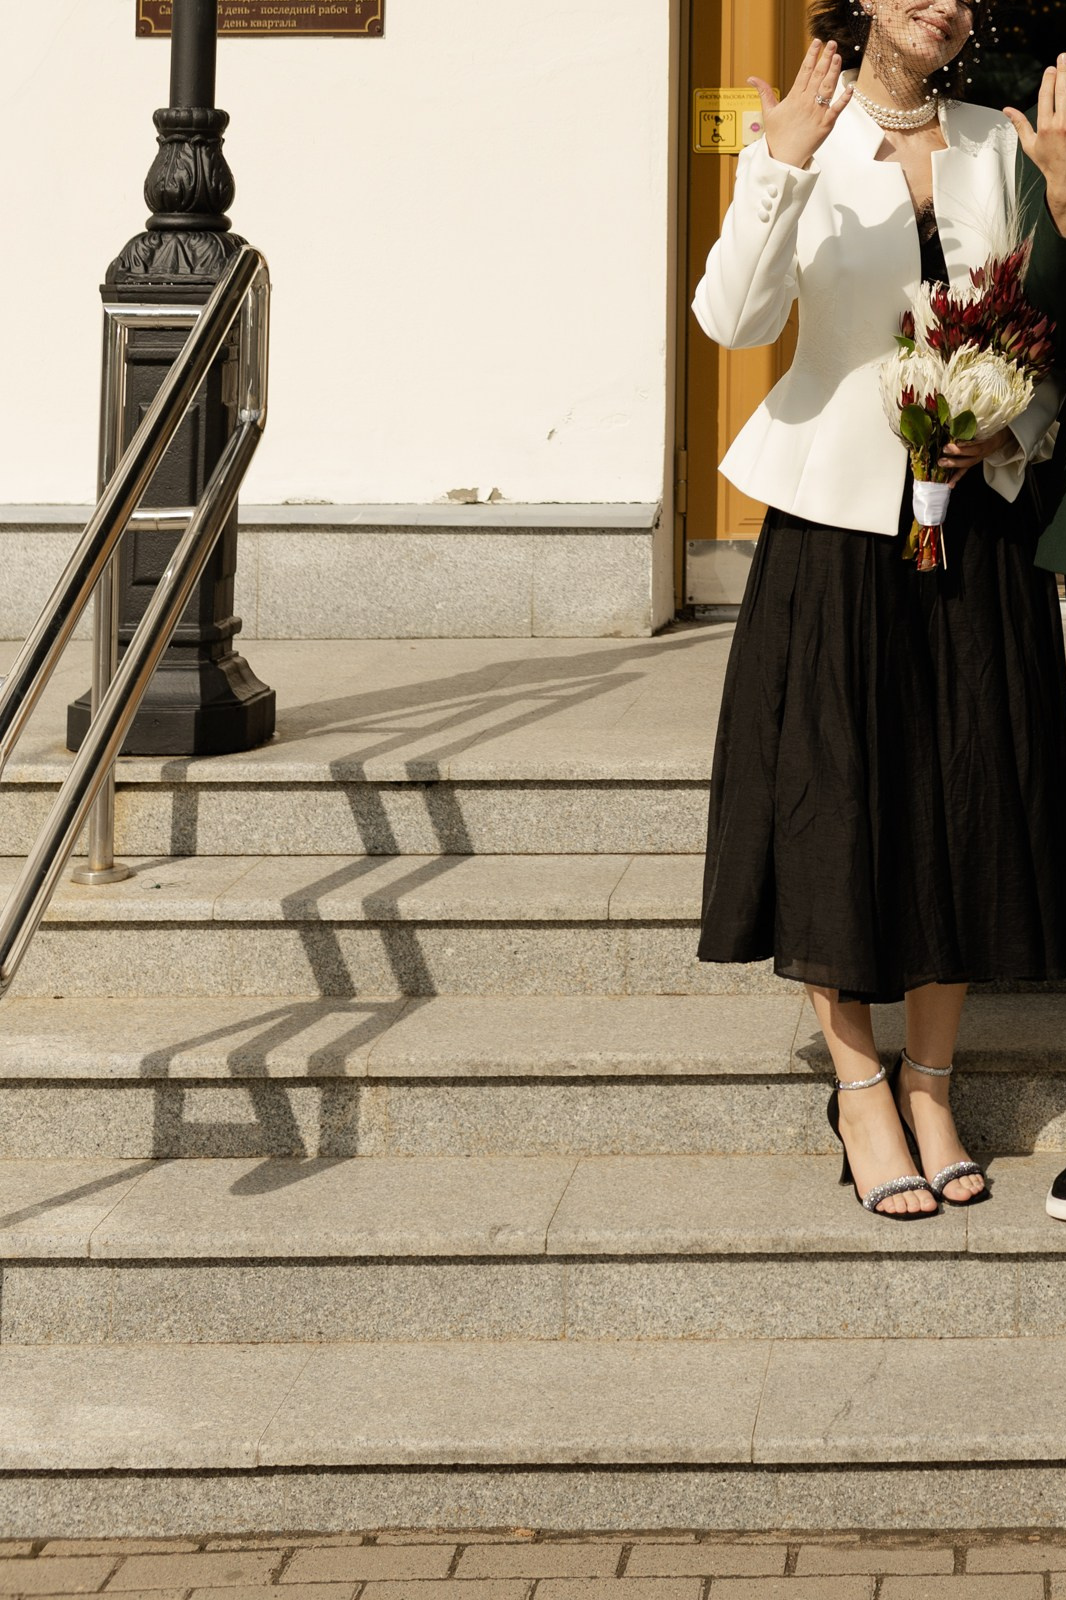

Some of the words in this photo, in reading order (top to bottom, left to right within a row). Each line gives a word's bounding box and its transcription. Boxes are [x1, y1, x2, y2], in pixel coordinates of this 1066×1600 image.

[225, 6, 250, 16] день
[260, 4, 316, 15] последний
[222, 19, 248, 29] день
[250, 19, 297, 30] квартала
